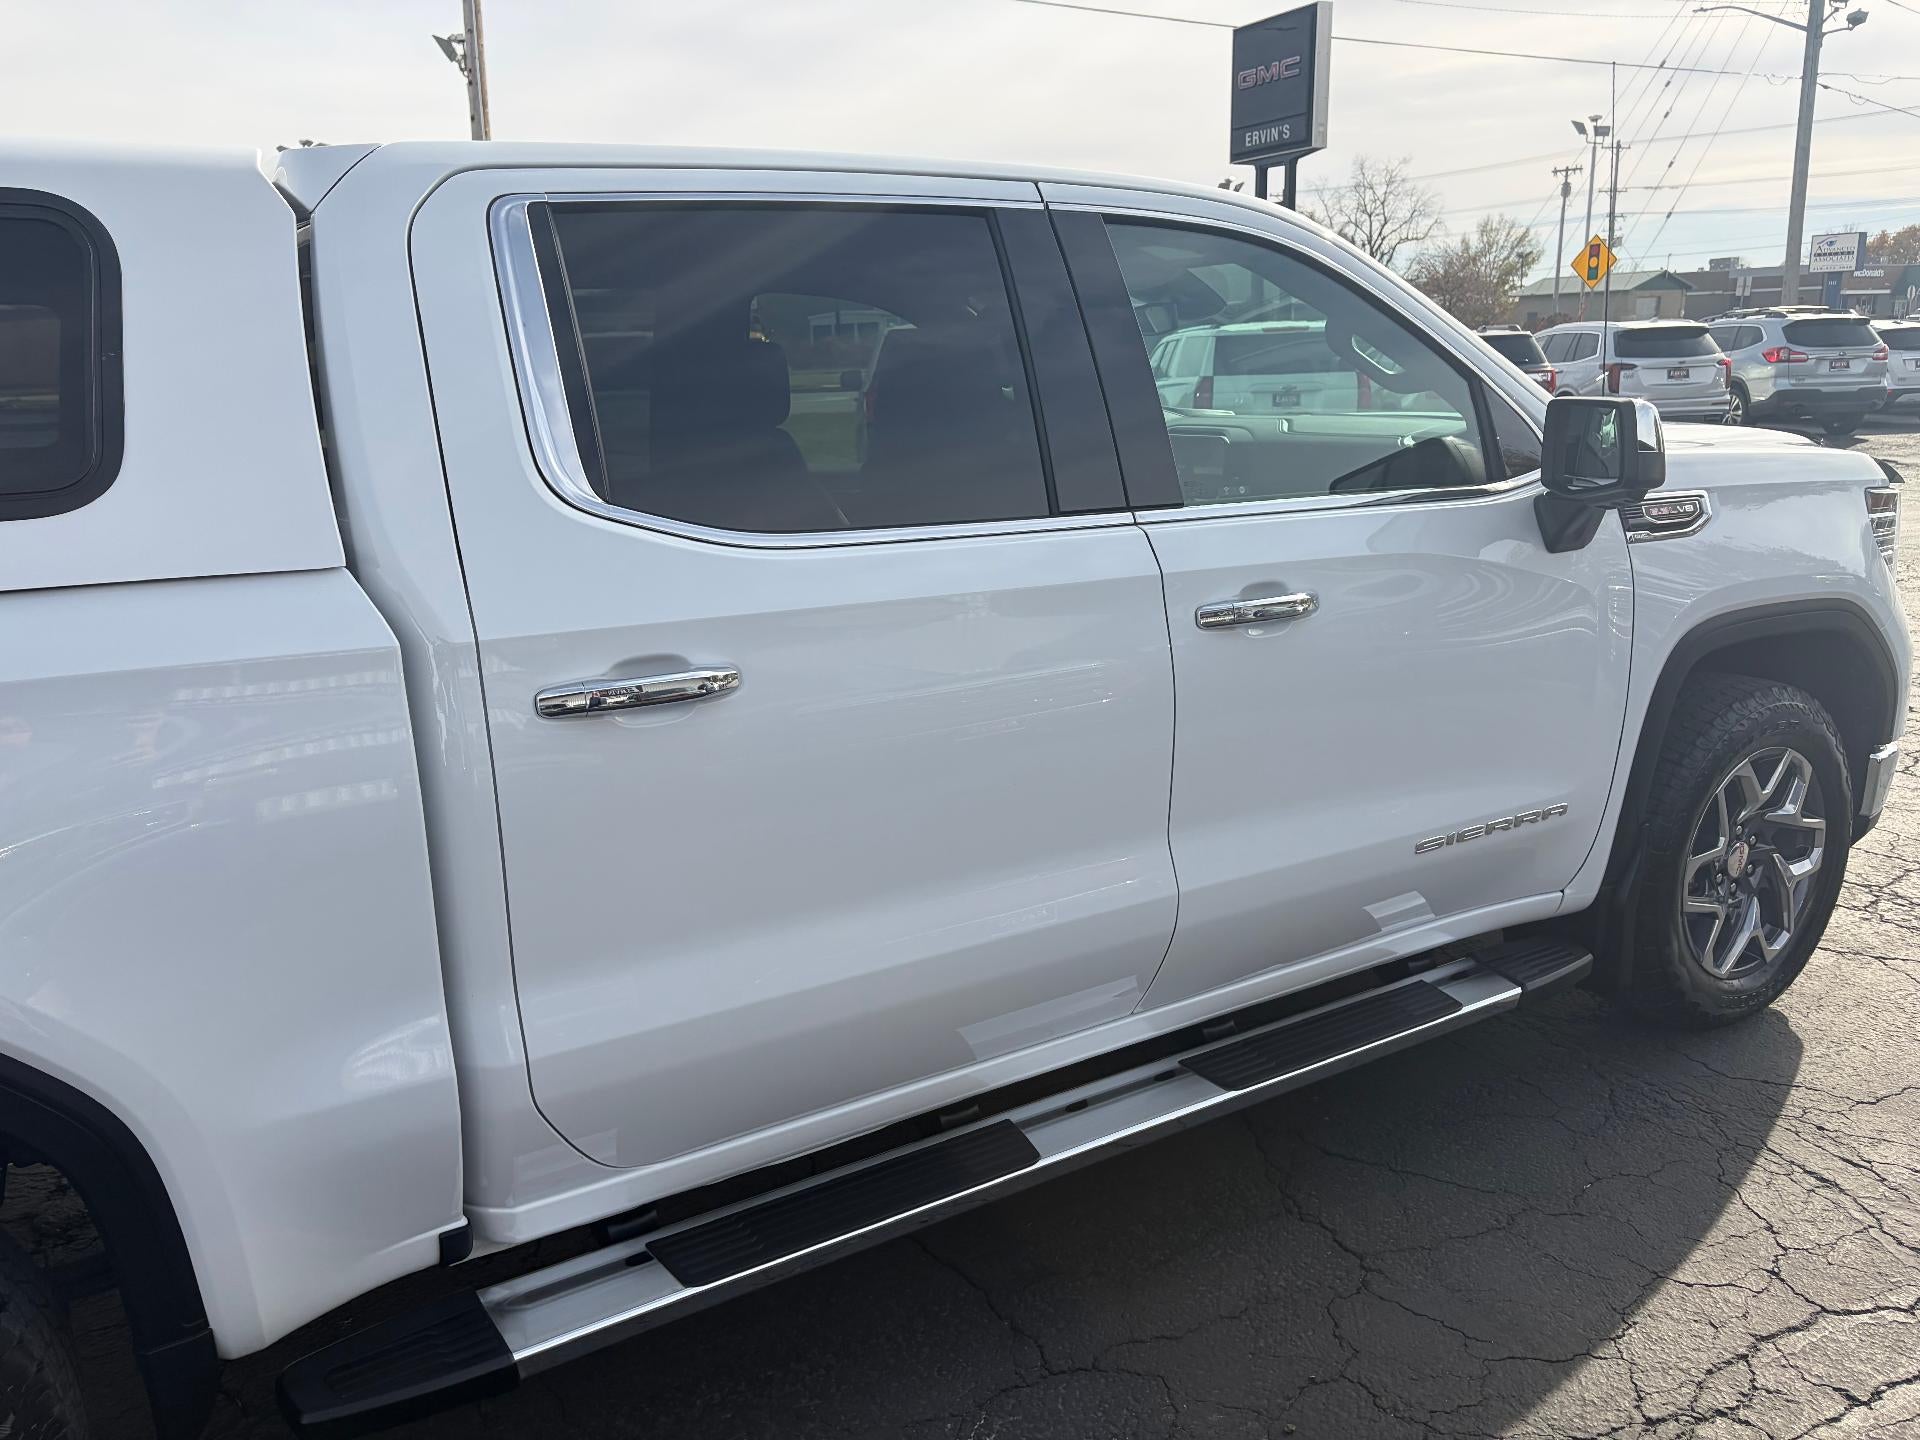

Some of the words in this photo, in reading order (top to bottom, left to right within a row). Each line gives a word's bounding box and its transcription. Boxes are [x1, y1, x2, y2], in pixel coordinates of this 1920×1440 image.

[1237, 55, 1301, 90] GMC
[1245, 124, 1290, 147] ERVIN'S
[1415, 802, 1569, 854] SIERRA
